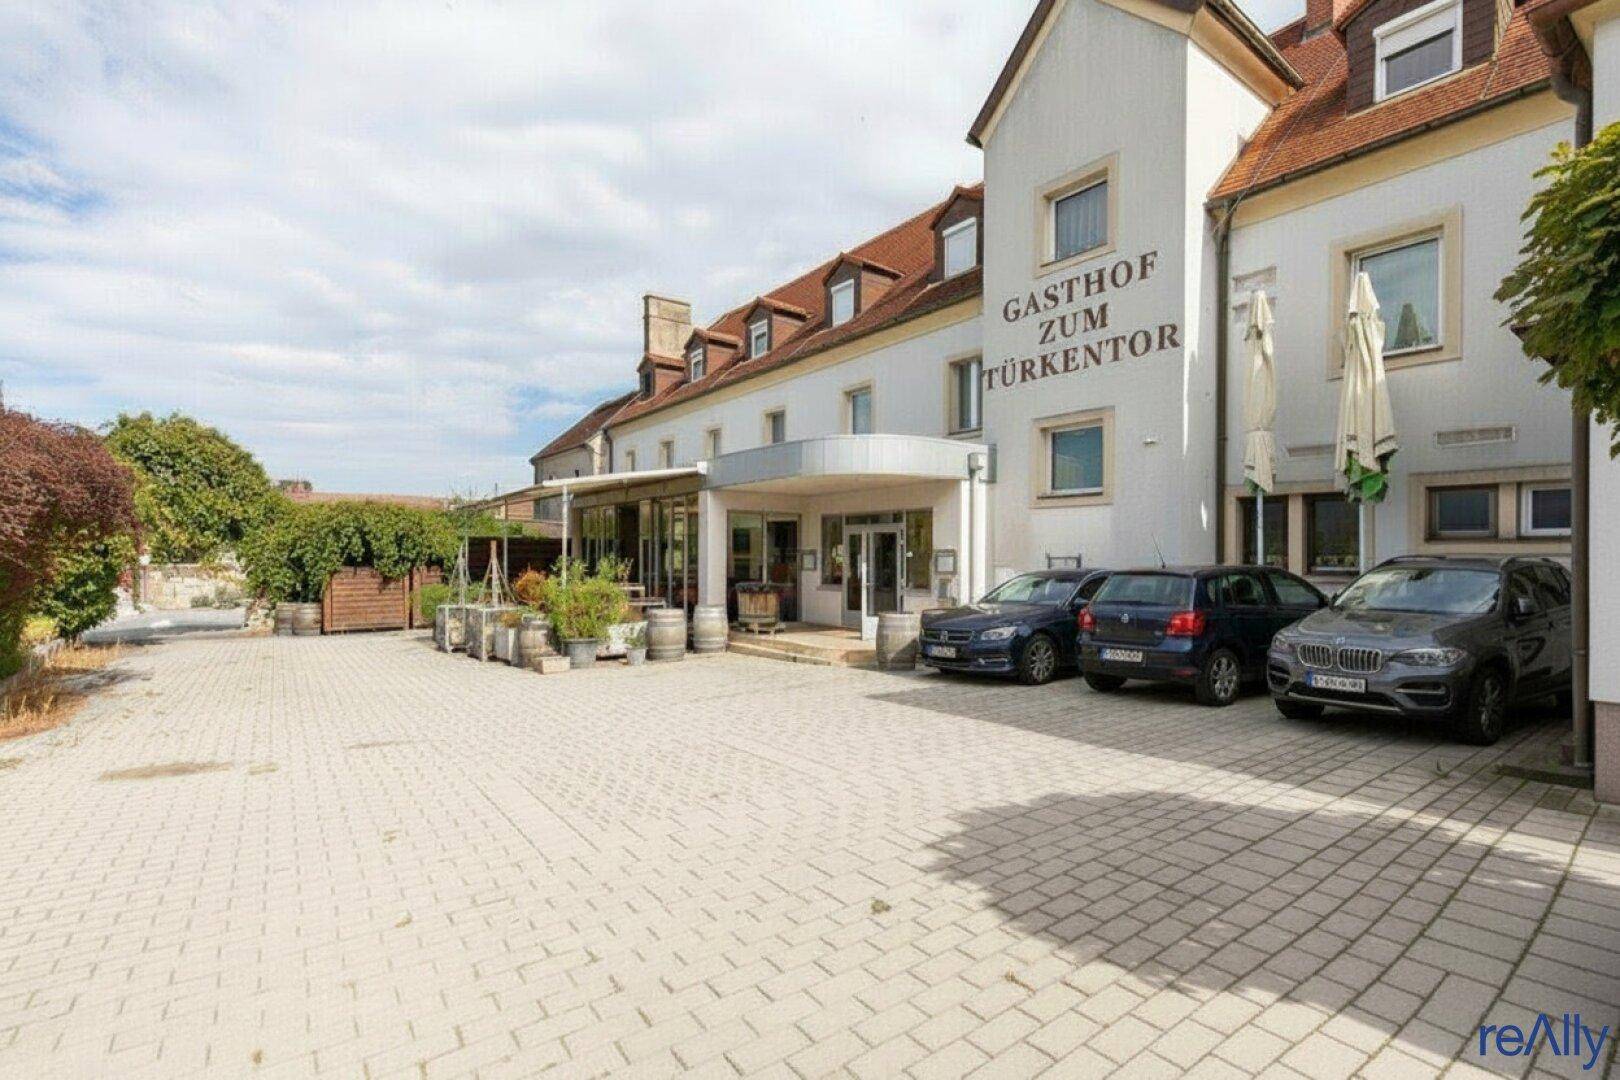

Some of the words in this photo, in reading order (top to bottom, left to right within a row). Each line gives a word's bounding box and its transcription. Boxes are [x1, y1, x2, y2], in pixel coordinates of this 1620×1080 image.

[1003, 250, 1158, 323] GASTHOF
[982, 323, 1180, 391] TÜRKENTOR
[1038, 302, 1109, 345] ZUM
